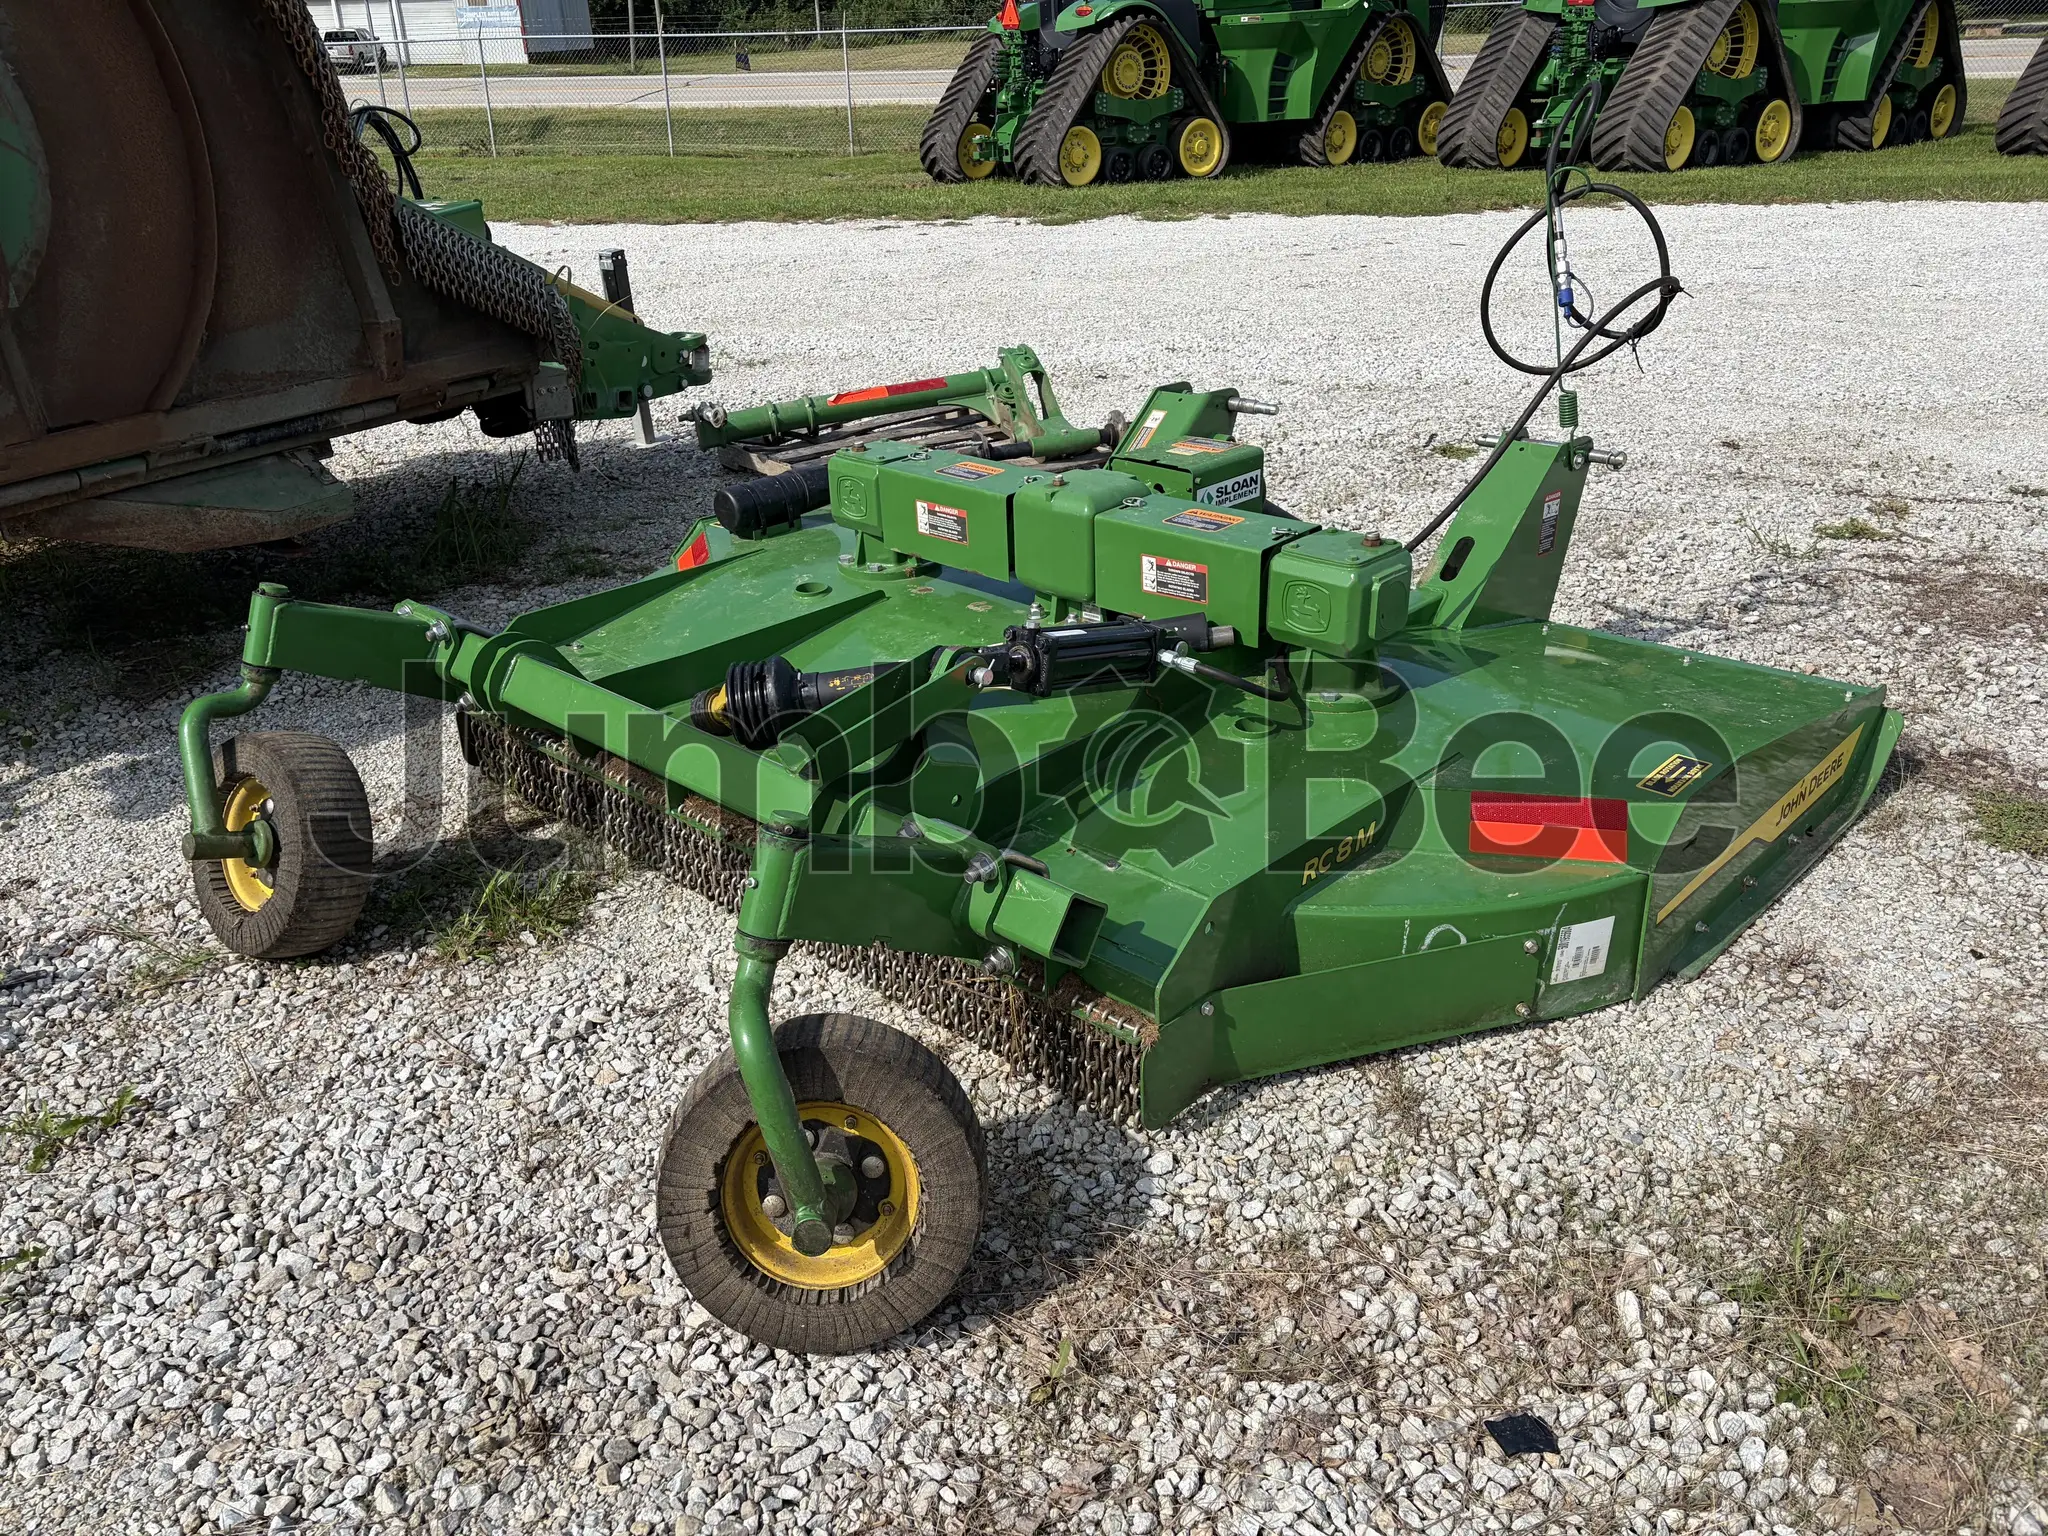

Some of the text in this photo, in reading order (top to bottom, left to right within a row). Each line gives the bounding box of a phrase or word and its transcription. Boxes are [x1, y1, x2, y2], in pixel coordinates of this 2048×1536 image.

[1215, 474, 1259, 499] SLOAN
[1215, 487, 1259, 507] IMPLEMENT
[939, 506, 959, 516] DANGER
[1199, 511, 1242, 522] WARNING
[1172, 561, 1197, 571] DANGER
[1659, 758, 1684, 776] ROTATION
[1776, 751, 1845, 827] JOHN DEERE
